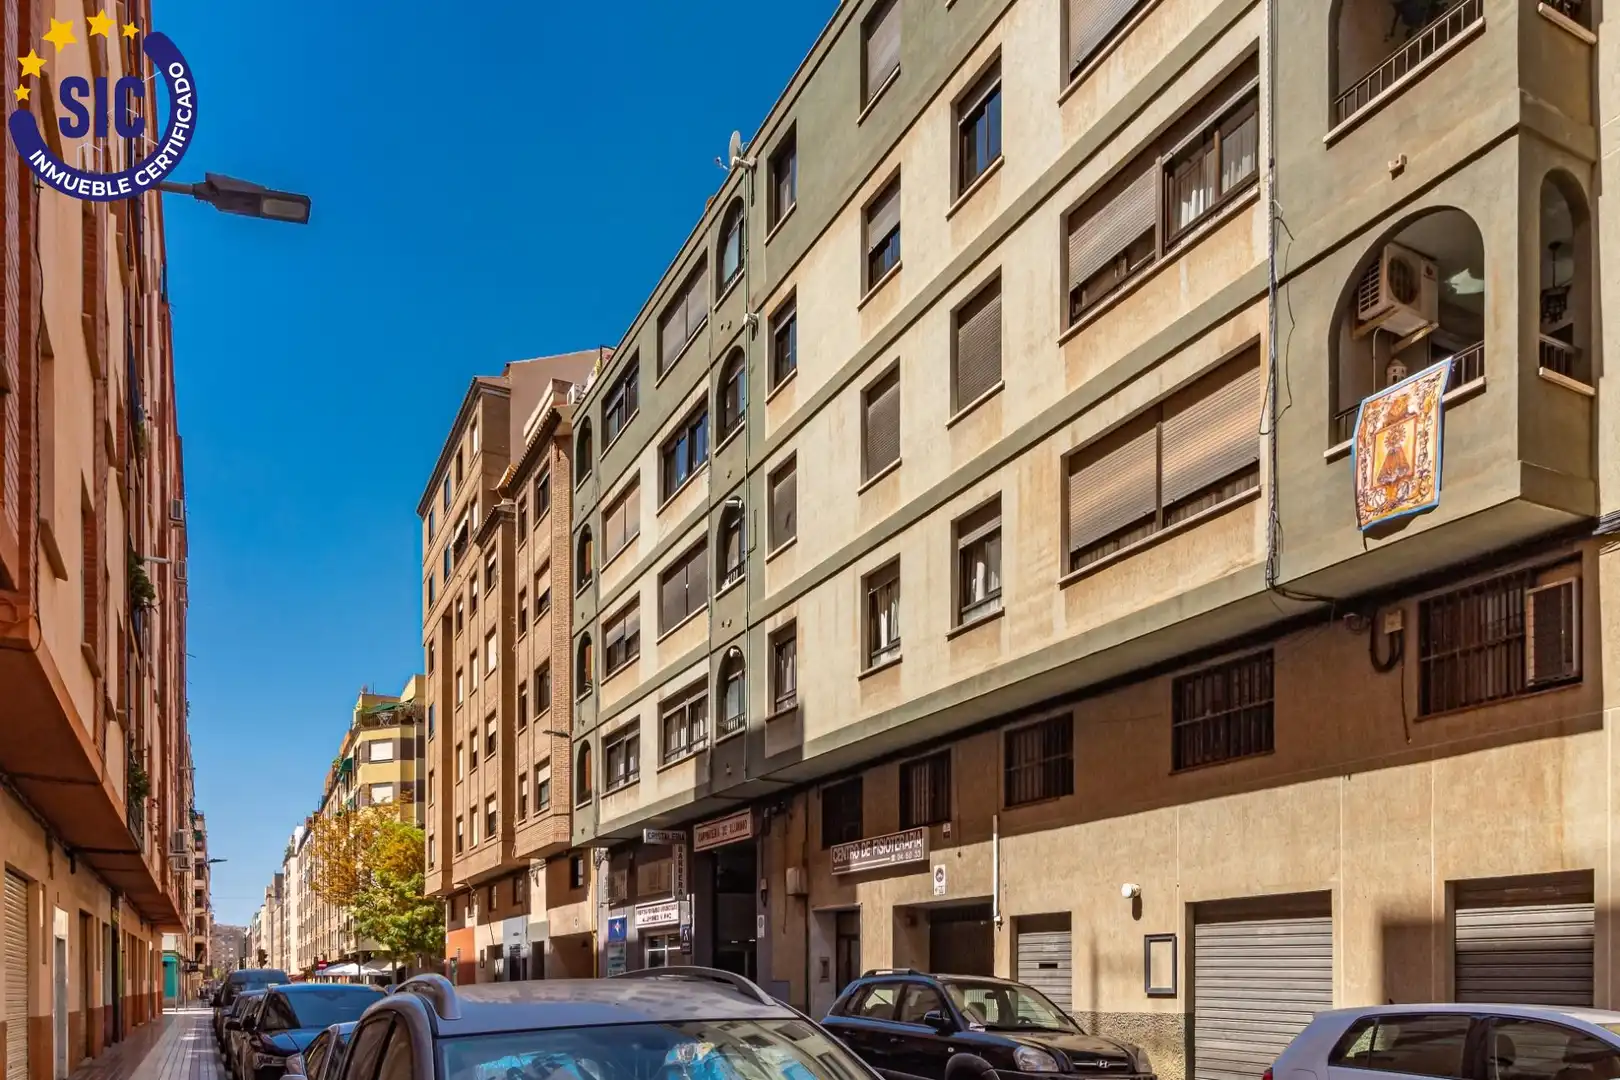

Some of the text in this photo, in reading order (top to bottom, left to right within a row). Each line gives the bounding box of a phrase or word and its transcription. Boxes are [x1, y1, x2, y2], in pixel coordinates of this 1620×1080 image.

[832, 830, 922, 863] CENTRO DE FISIOTERAPIA
